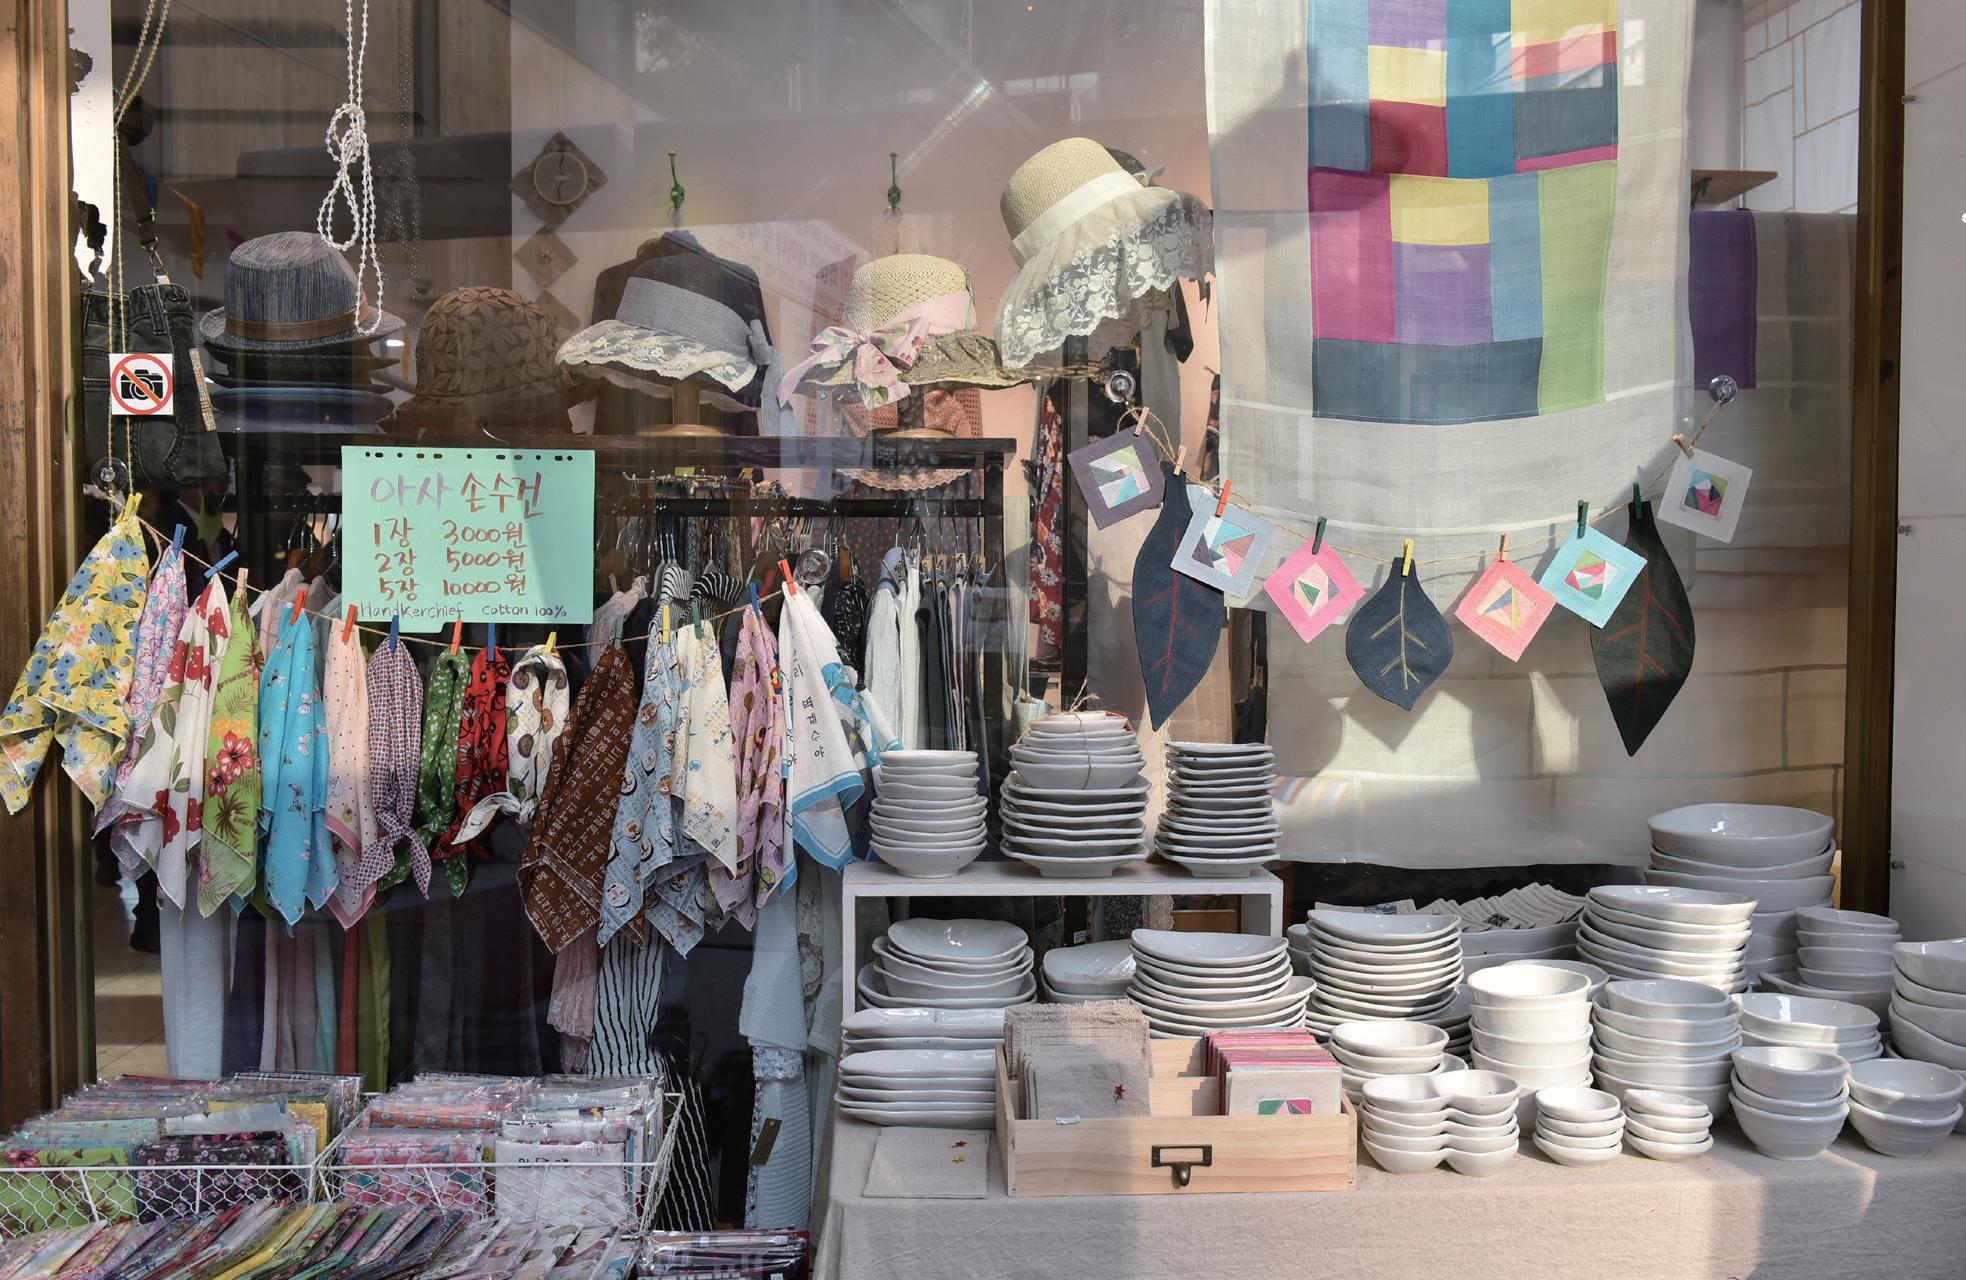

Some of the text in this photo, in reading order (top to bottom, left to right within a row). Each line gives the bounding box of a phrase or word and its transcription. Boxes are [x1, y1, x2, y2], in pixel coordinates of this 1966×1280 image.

[370, 472, 544, 519] 아사 손수건
[373, 517, 527, 549] 1장 3000원
[374, 547, 526, 576] 2장 5000원
[379, 573, 526, 601] 5장 10000원
[535, 604, 567, 619] 100%
